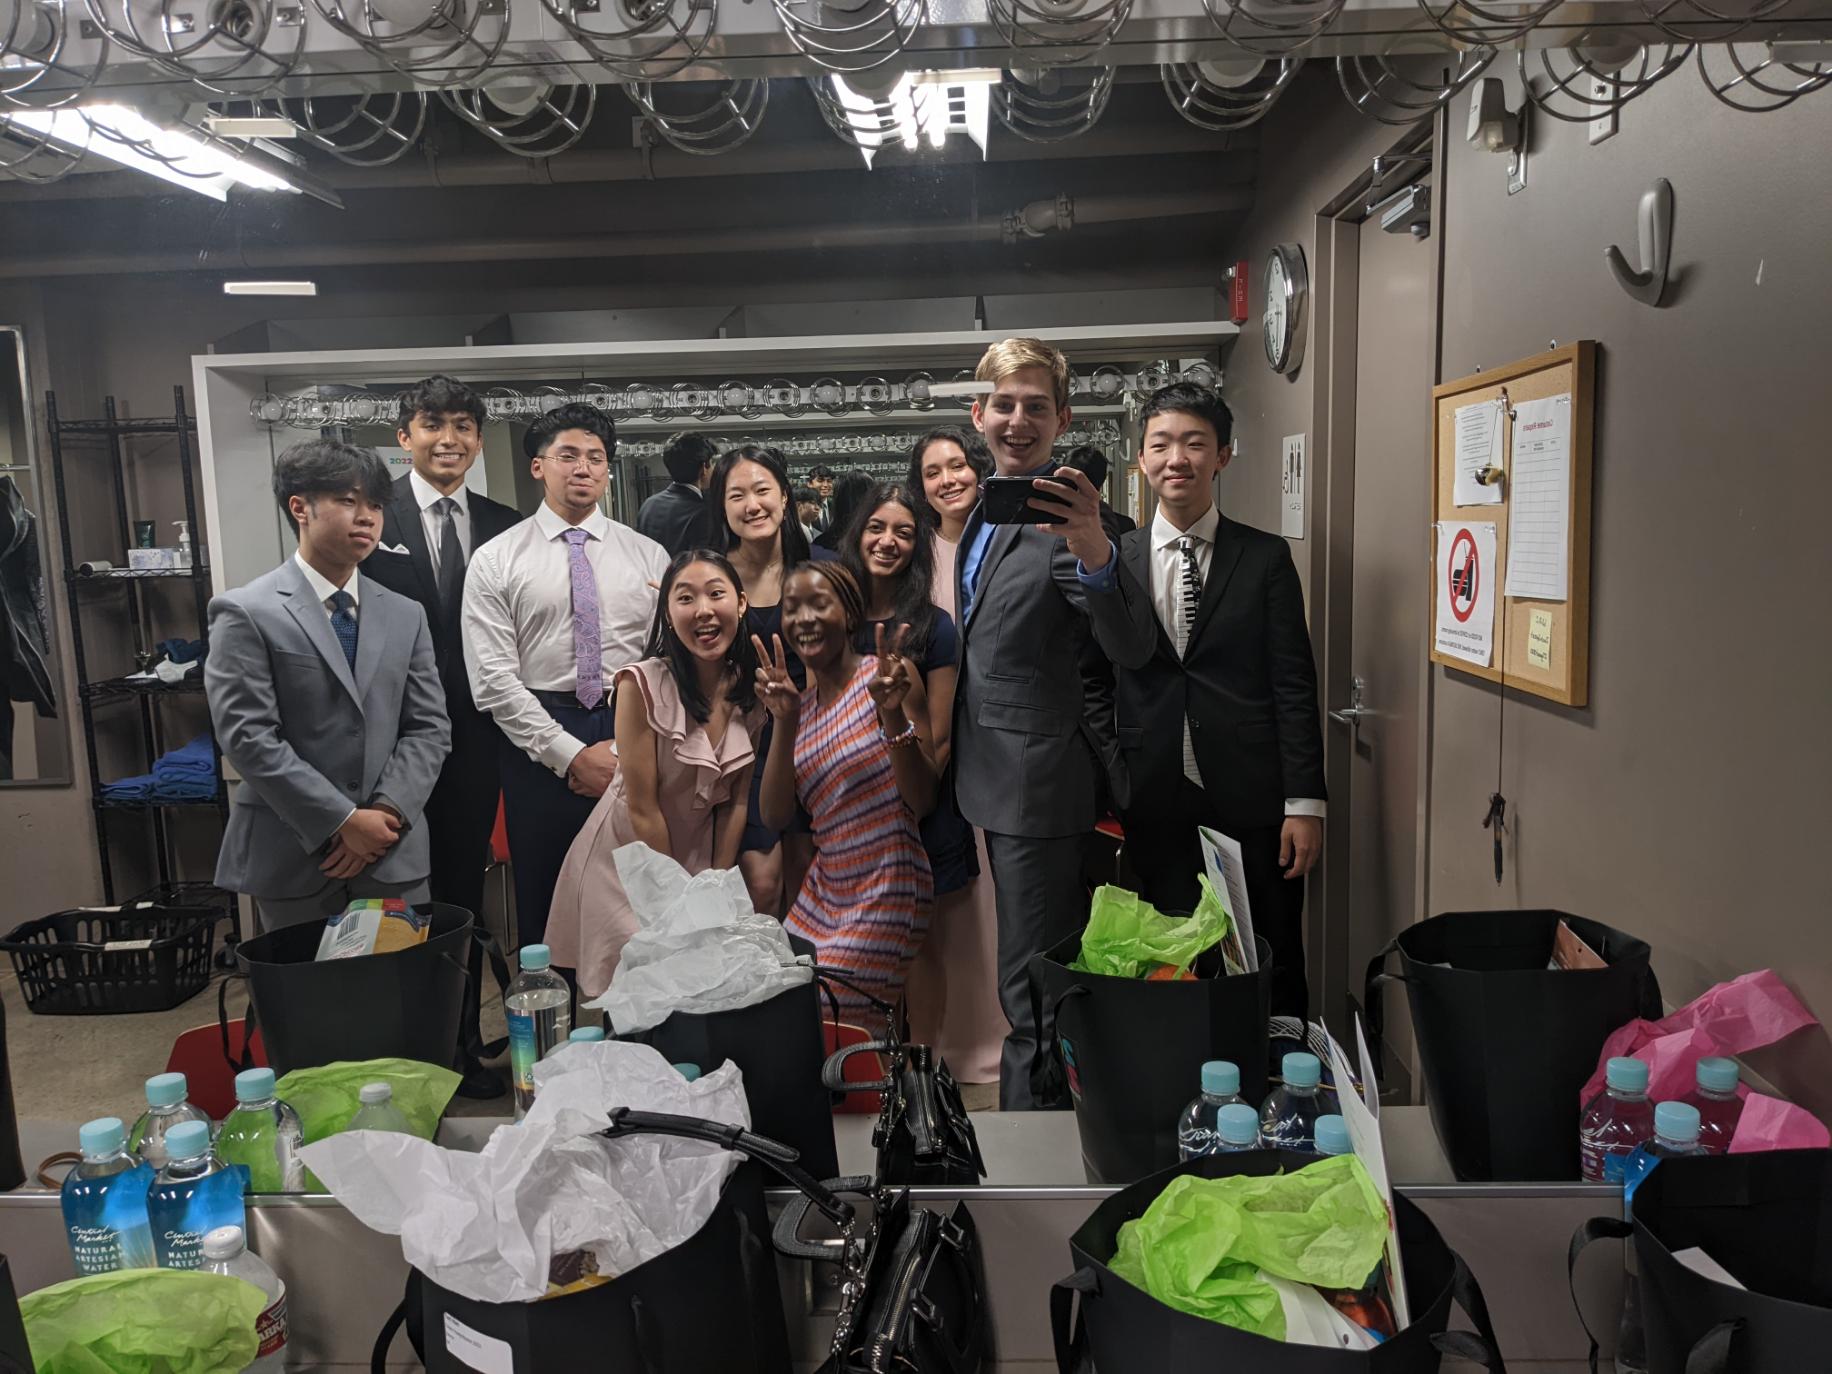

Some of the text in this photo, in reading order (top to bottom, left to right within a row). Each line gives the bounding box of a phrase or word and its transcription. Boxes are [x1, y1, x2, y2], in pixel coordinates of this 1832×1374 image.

[389, 457, 413, 465] 2022
[71, 1225, 109, 1234] Central
[76, 1230, 121, 1243] Market
[170, 1236, 207, 1248] Mark
[74, 1244, 122, 1254] NATURAL
[75, 1252, 124, 1263] ARTESIAN
[82, 1262, 118, 1272] WATER
